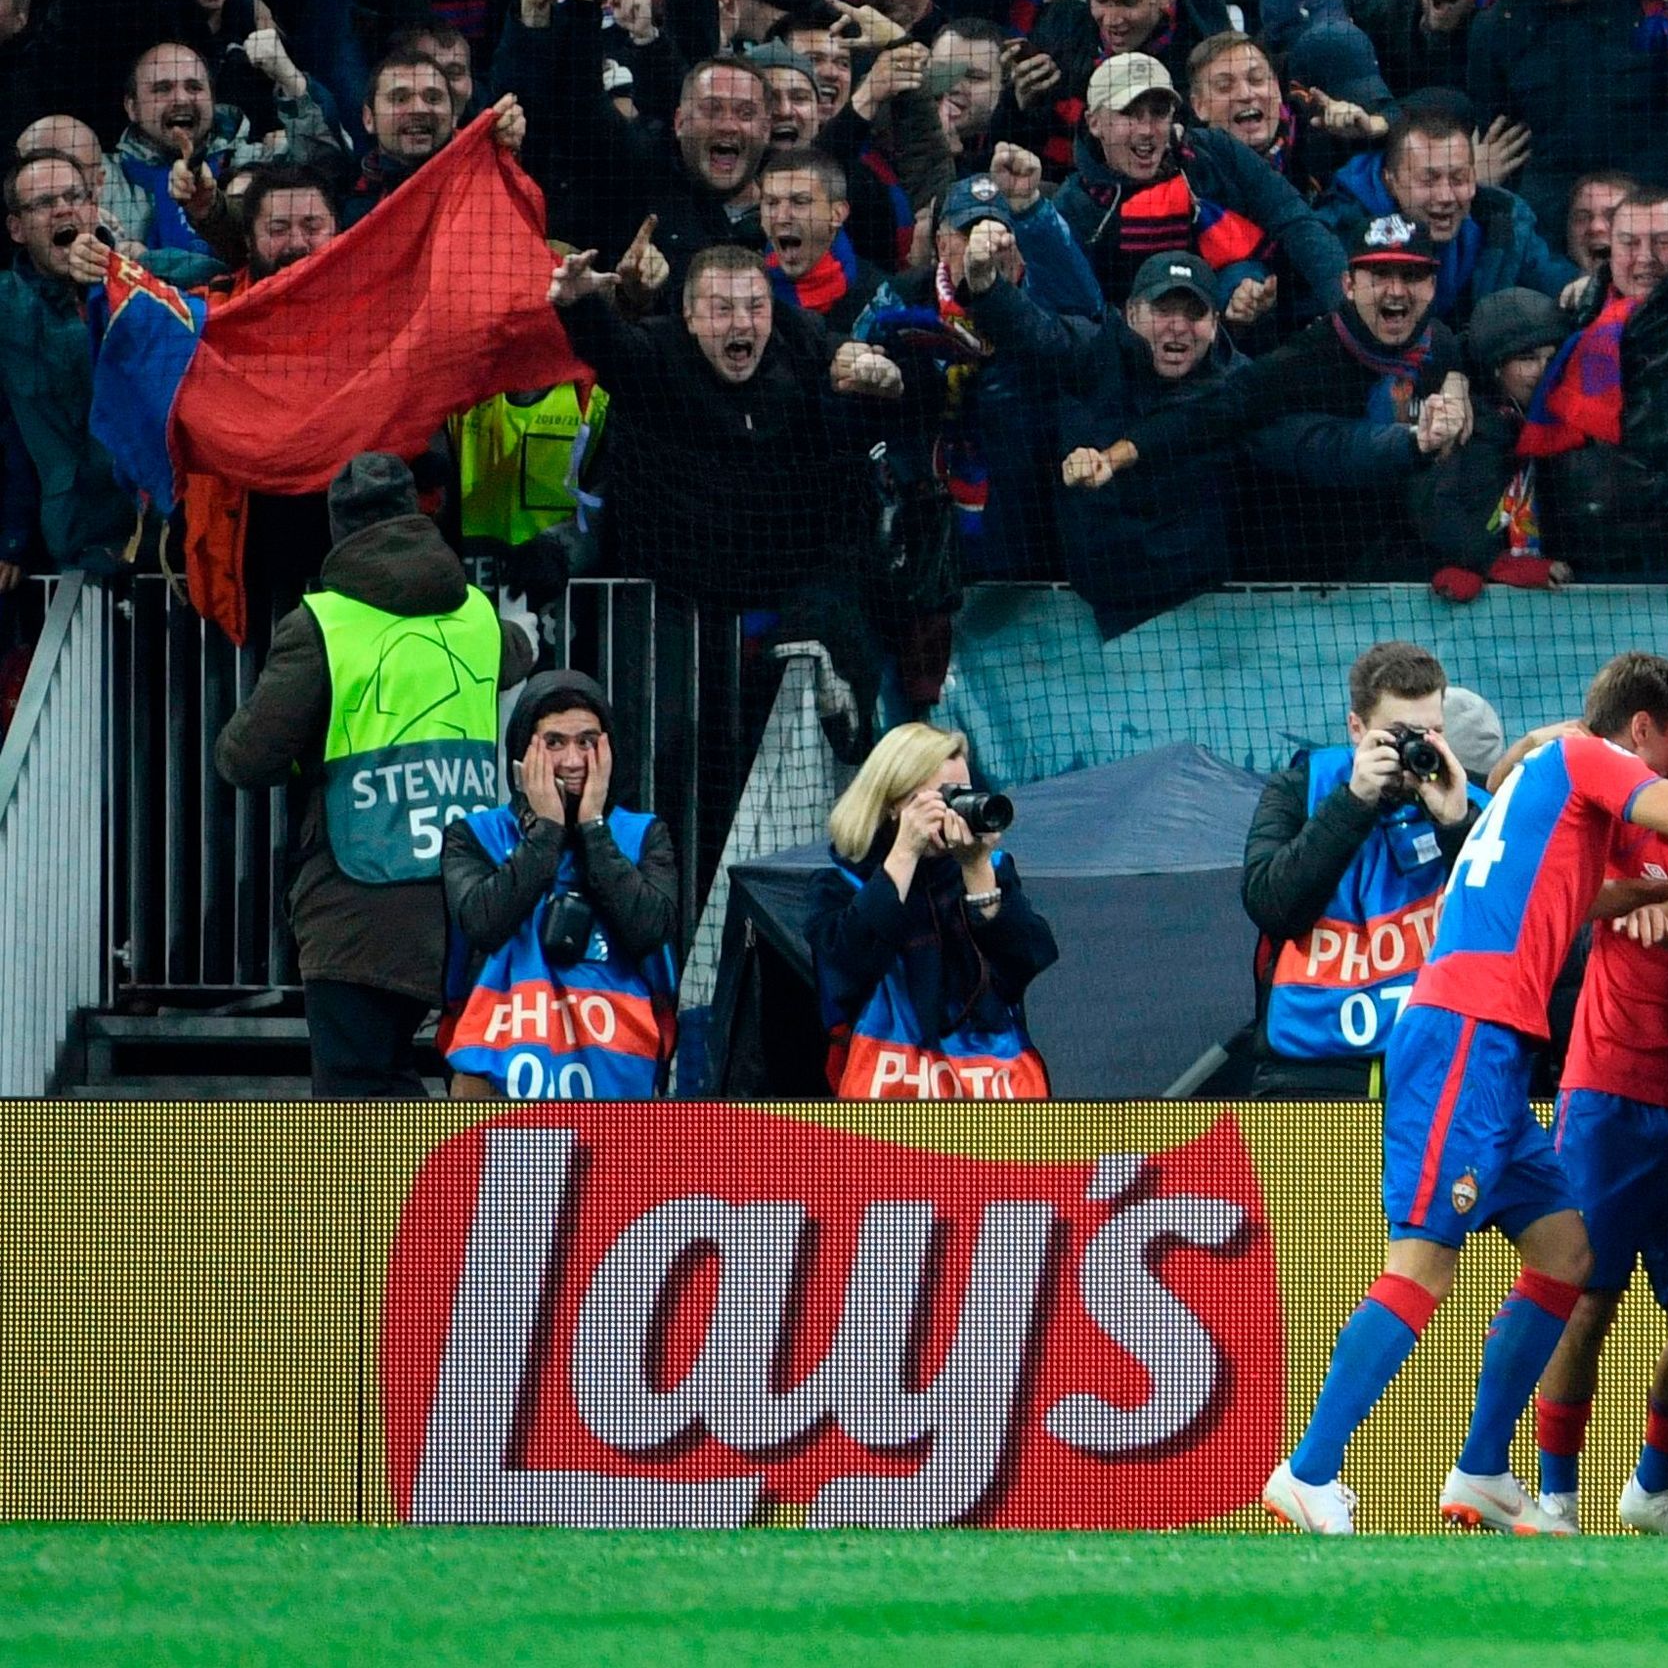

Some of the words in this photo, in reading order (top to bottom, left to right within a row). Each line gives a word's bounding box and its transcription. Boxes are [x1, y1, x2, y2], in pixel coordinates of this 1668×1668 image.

[353, 759, 498, 810] STEWAR
[1306, 908, 1442, 983] PHOT
[870, 1050, 1015, 1100] PHOTO
[410, 1128, 1250, 1529] Lay's
